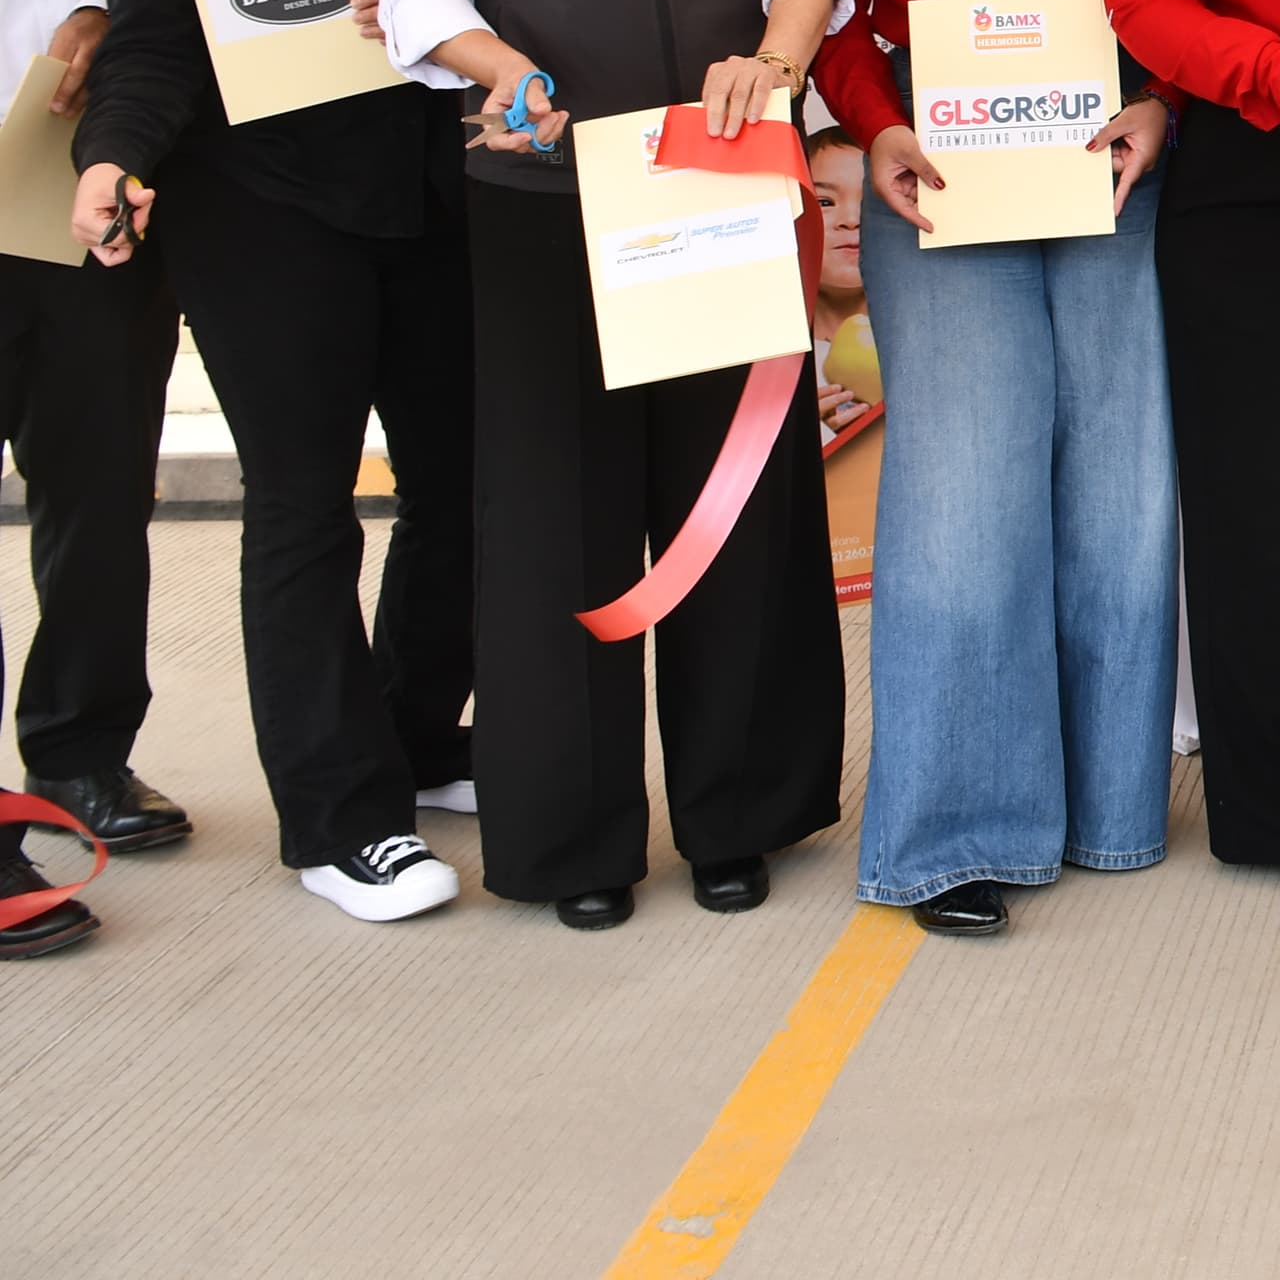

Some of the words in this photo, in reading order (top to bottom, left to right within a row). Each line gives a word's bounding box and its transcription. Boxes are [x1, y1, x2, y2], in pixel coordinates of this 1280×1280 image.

[283, 0, 311, 11] DESDE
[995, 13, 1041, 28] BAMX
[976, 36, 1041, 48] HERMOSILLO
[929, 132, 1010, 148] FORWARDING
[1022, 130, 1053, 144] YOUR
[1066, 128, 1102, 141] IDEA
[616, 246, 685, 265] CHEVROLET
